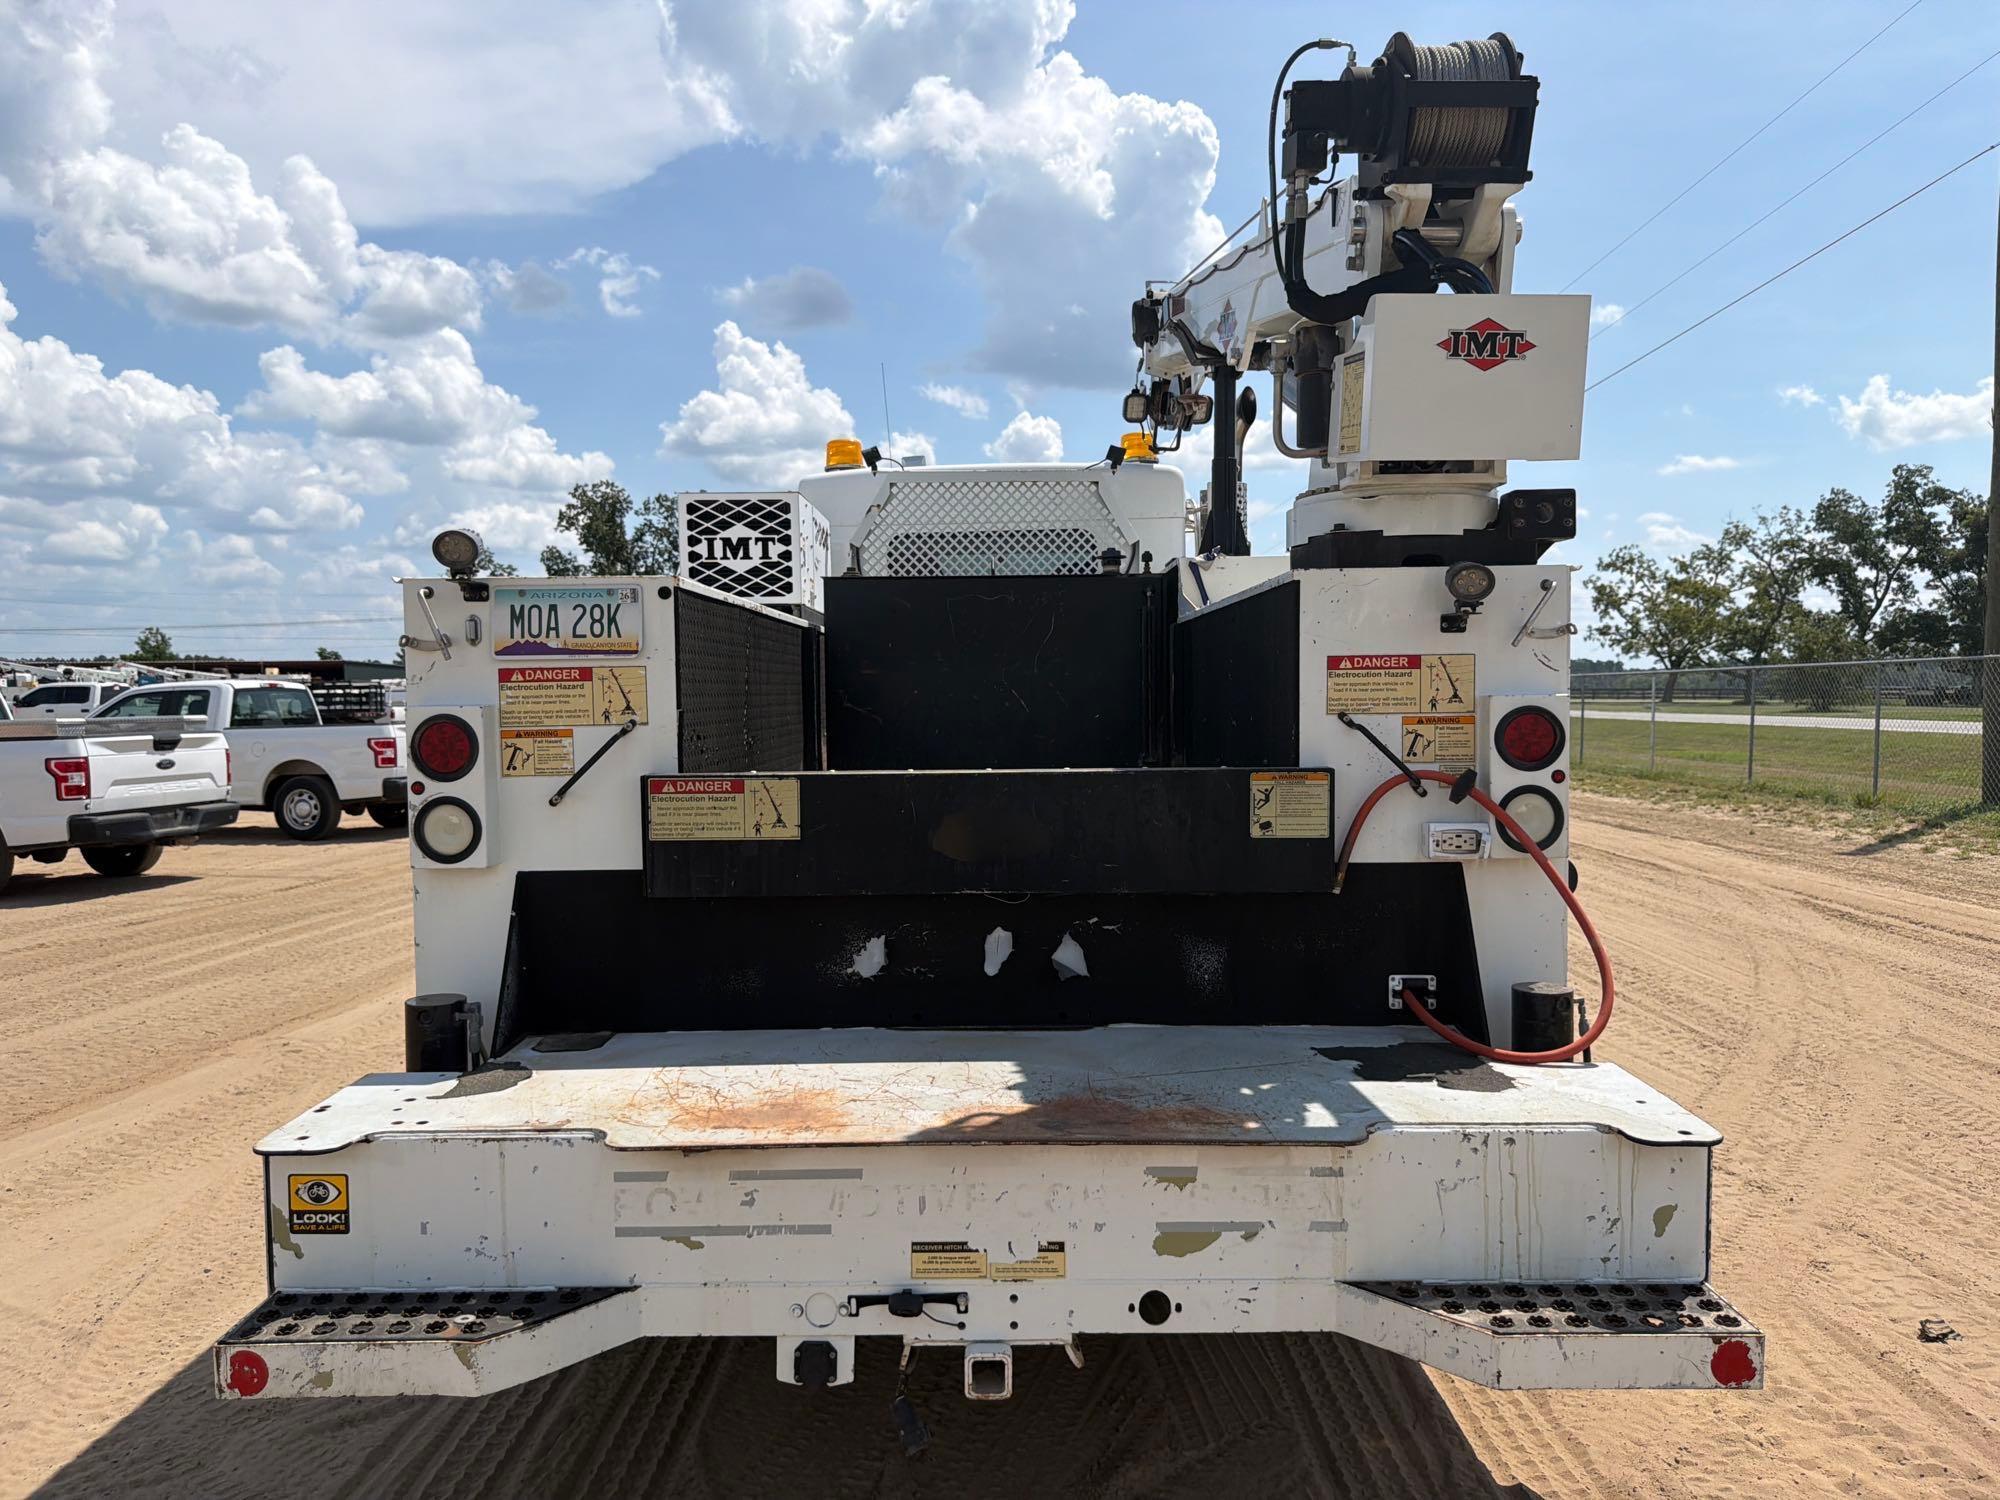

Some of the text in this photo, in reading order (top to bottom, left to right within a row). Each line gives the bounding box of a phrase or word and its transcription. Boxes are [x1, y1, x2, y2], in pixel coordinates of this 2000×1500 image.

[1448, 331, 1525, 358] IMT
[704, 537, 776, 560] IMT
[572, 604, 622, 639] 28K
[1354, 657, 1408, 668] DANGER
[525, 670, 580, 680] DANGER
[677, 781, 732, 792] DANGER
[293, 1214, 345, 1223] LOOK!
